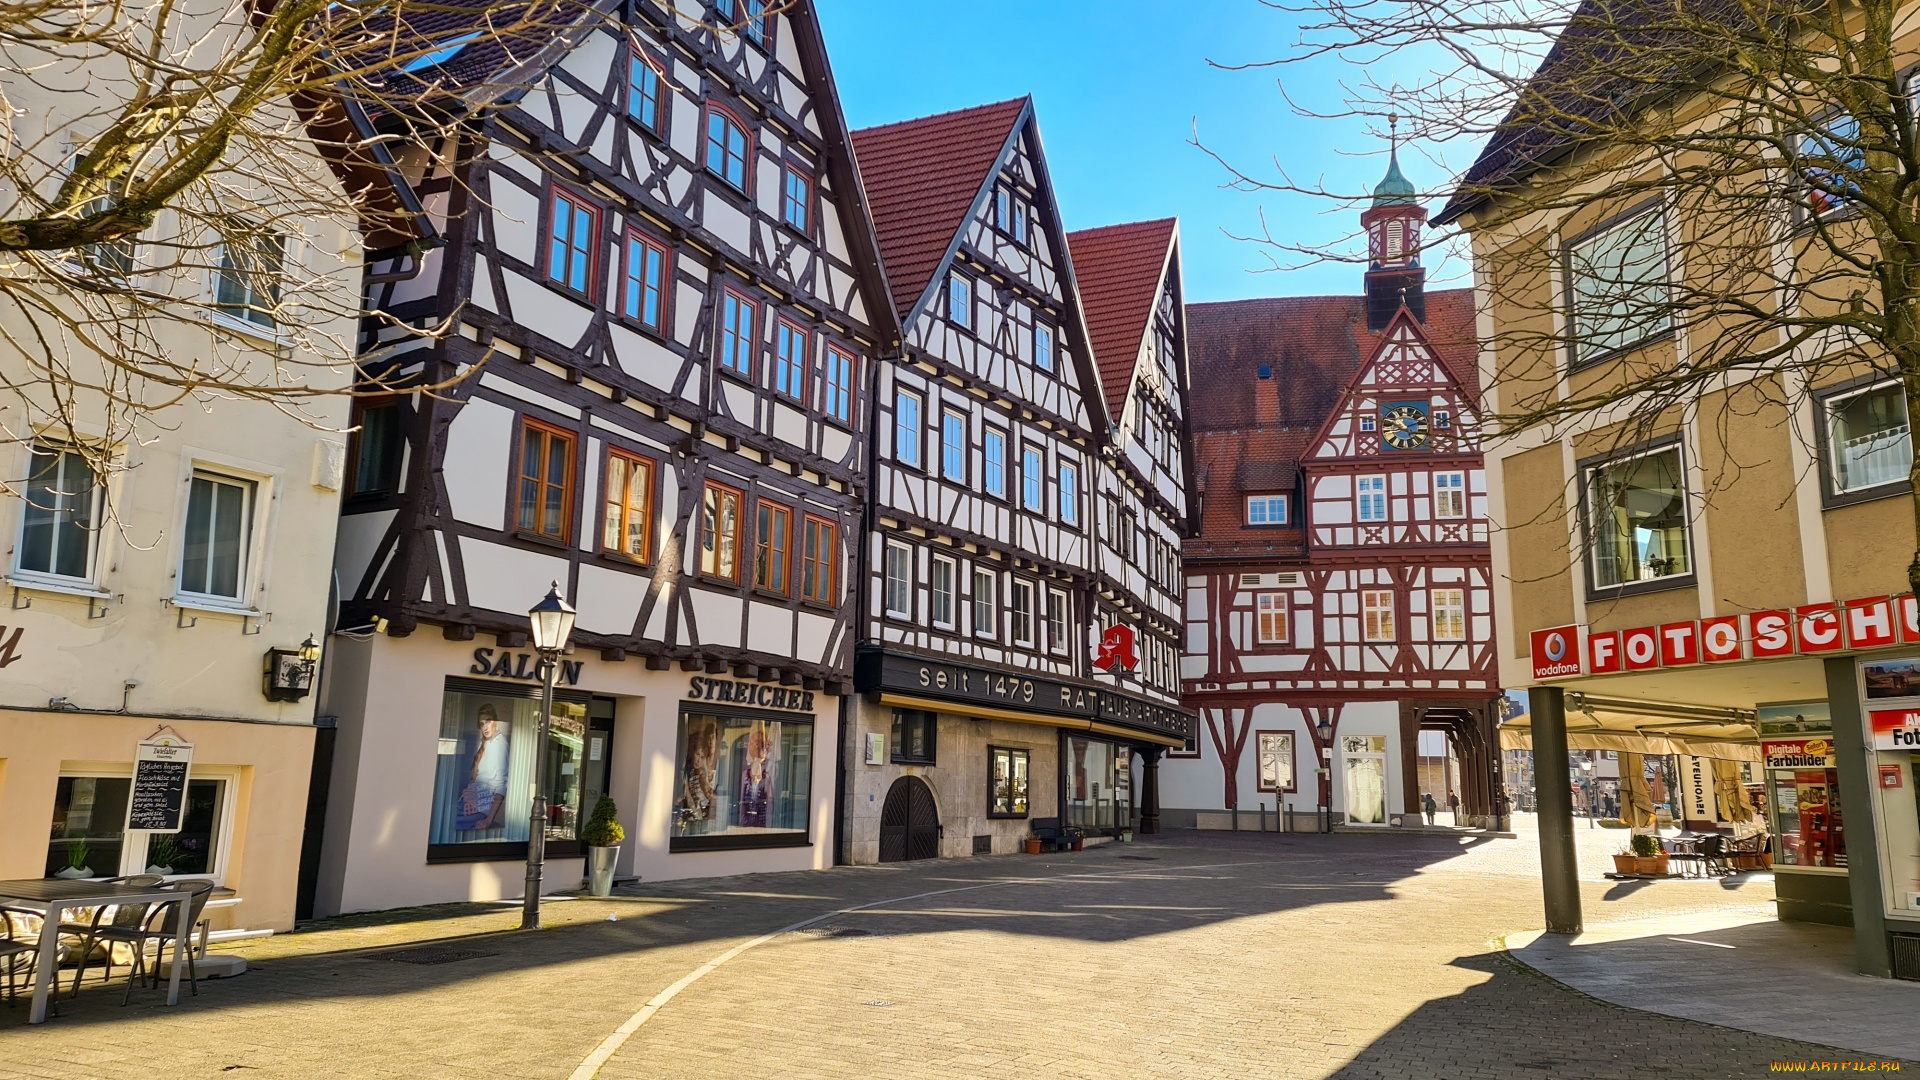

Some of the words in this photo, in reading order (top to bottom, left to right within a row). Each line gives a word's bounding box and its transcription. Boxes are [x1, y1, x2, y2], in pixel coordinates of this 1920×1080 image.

[1535, 663, 1579, 677] vodafone
[920, 668, 969, 693] seit
[984, 673, 1035, 703] 1479
[688, 675, 815, 712] STREICHER
[153, 747, 177, 755] Zwiefalter
[1767, 744, 1801, 756] Digitale
[1806, 741, 1825, 751] Sofort
[1766, 754, 1827, 768] Farbbilder
